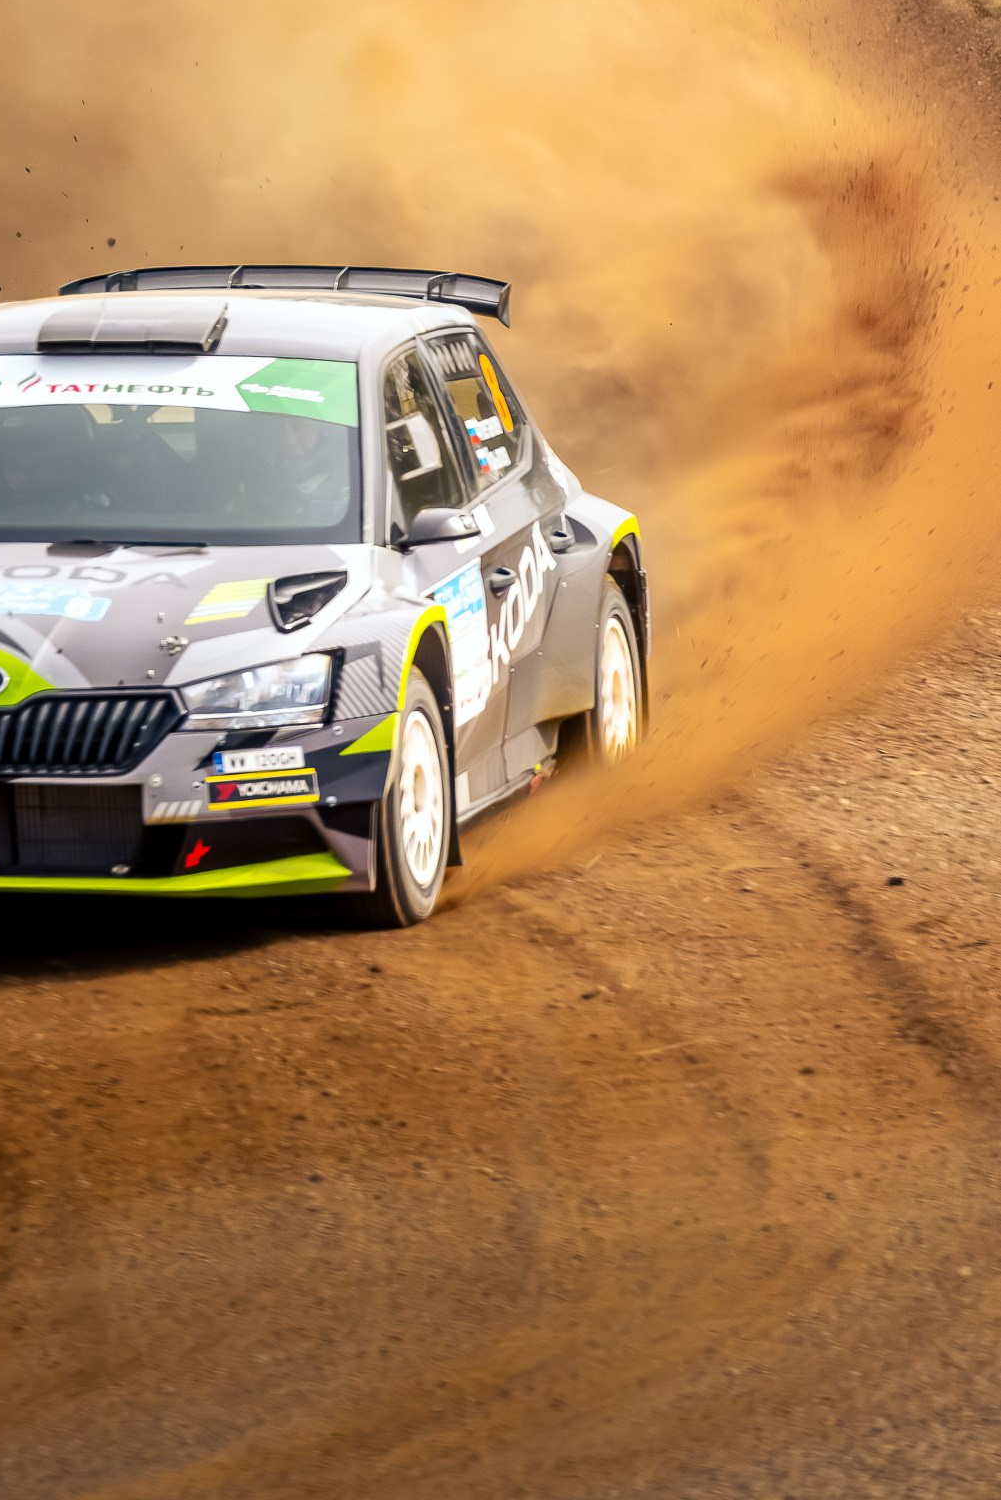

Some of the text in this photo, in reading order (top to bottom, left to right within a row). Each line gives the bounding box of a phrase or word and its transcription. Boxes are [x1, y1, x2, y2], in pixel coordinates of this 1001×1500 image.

[46, 382, 215, 397] ТАТНЕФТЬ
[479, 353, 513, 432] 8
[474, 520, 558, 695] KODA
[238, 779, 310, 797] YOKOHAMA
